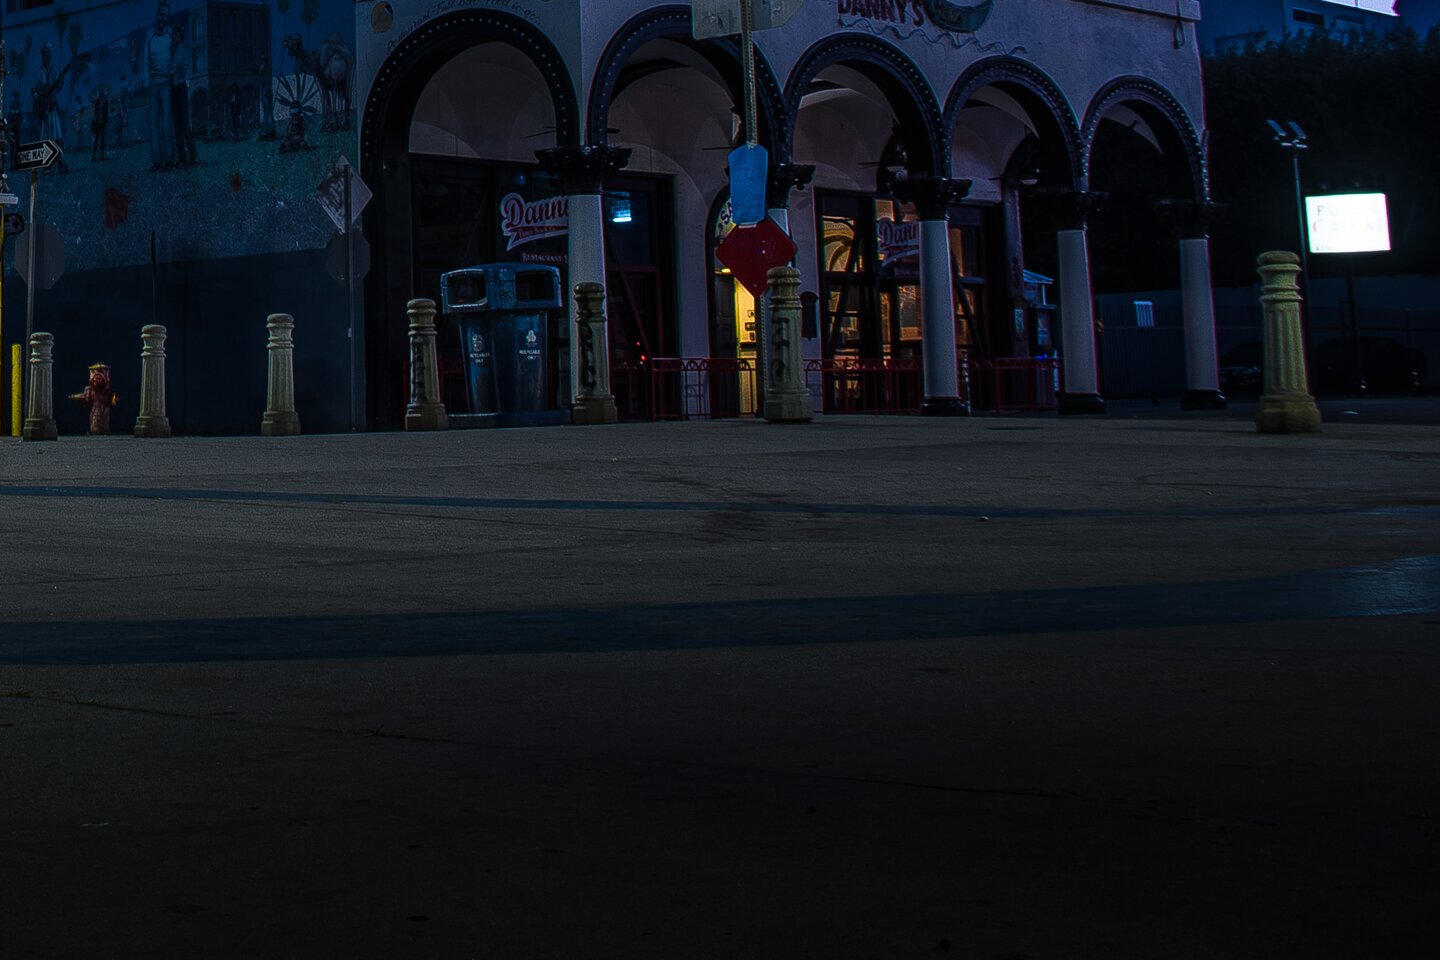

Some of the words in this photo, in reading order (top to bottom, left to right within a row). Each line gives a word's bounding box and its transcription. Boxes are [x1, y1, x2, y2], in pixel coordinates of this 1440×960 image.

[18, 150, 31, 162] ONE
[31, 149, 44, 161] WAY
[504, 196, 568, 228] Dann
